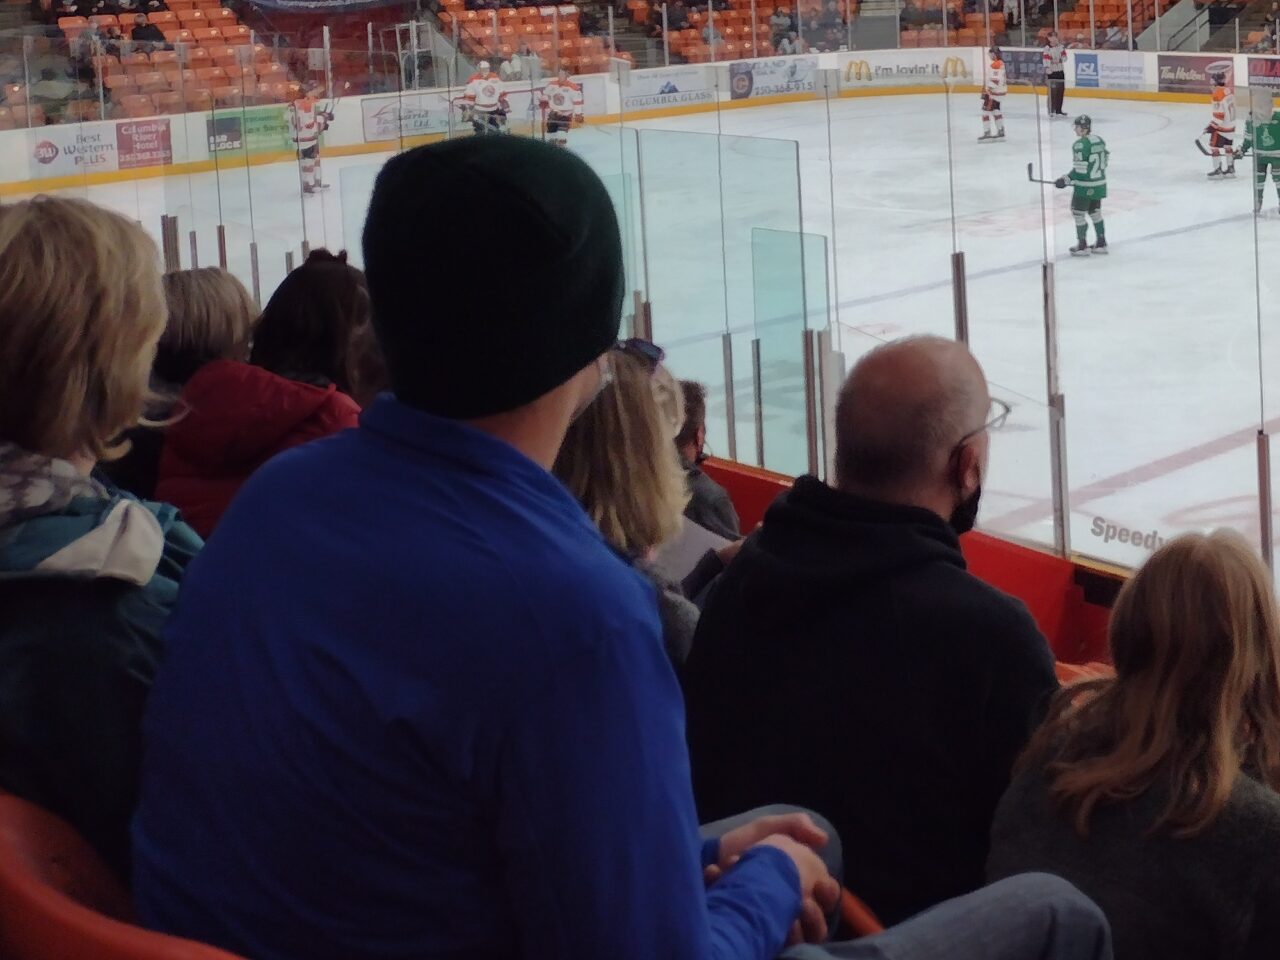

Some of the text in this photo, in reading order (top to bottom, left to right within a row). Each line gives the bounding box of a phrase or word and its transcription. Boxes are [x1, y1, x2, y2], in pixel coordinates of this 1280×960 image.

[1077, 63, 1097, 75] ISL
[625, 91, 713, 107] COLUMBIA GLASS
[64, 144, 114, 155] Western
